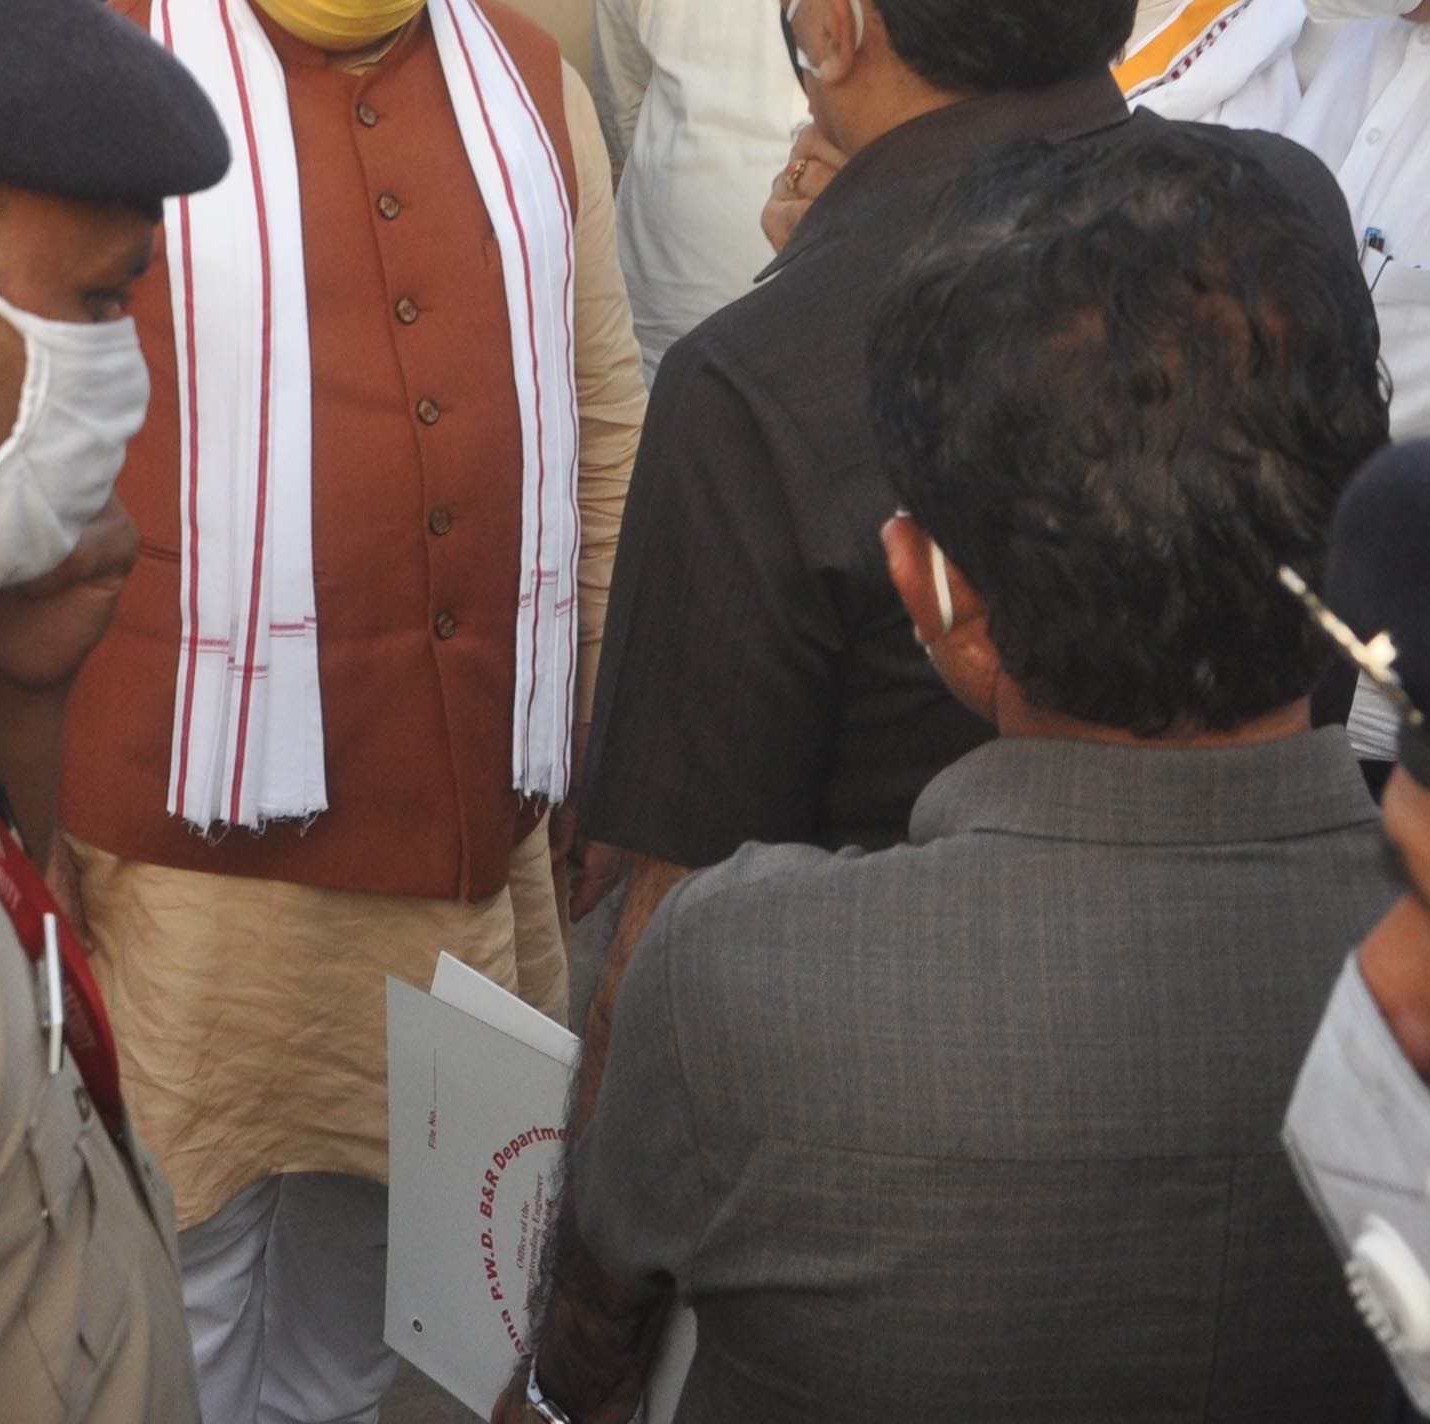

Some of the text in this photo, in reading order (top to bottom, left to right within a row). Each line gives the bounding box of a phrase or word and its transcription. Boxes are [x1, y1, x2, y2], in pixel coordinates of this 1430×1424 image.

[492, 1125, 571, 1171] Departme
[479, 1169, 501, 1219] B&R
[480, 1227, 504, 1303] P.W.D.
